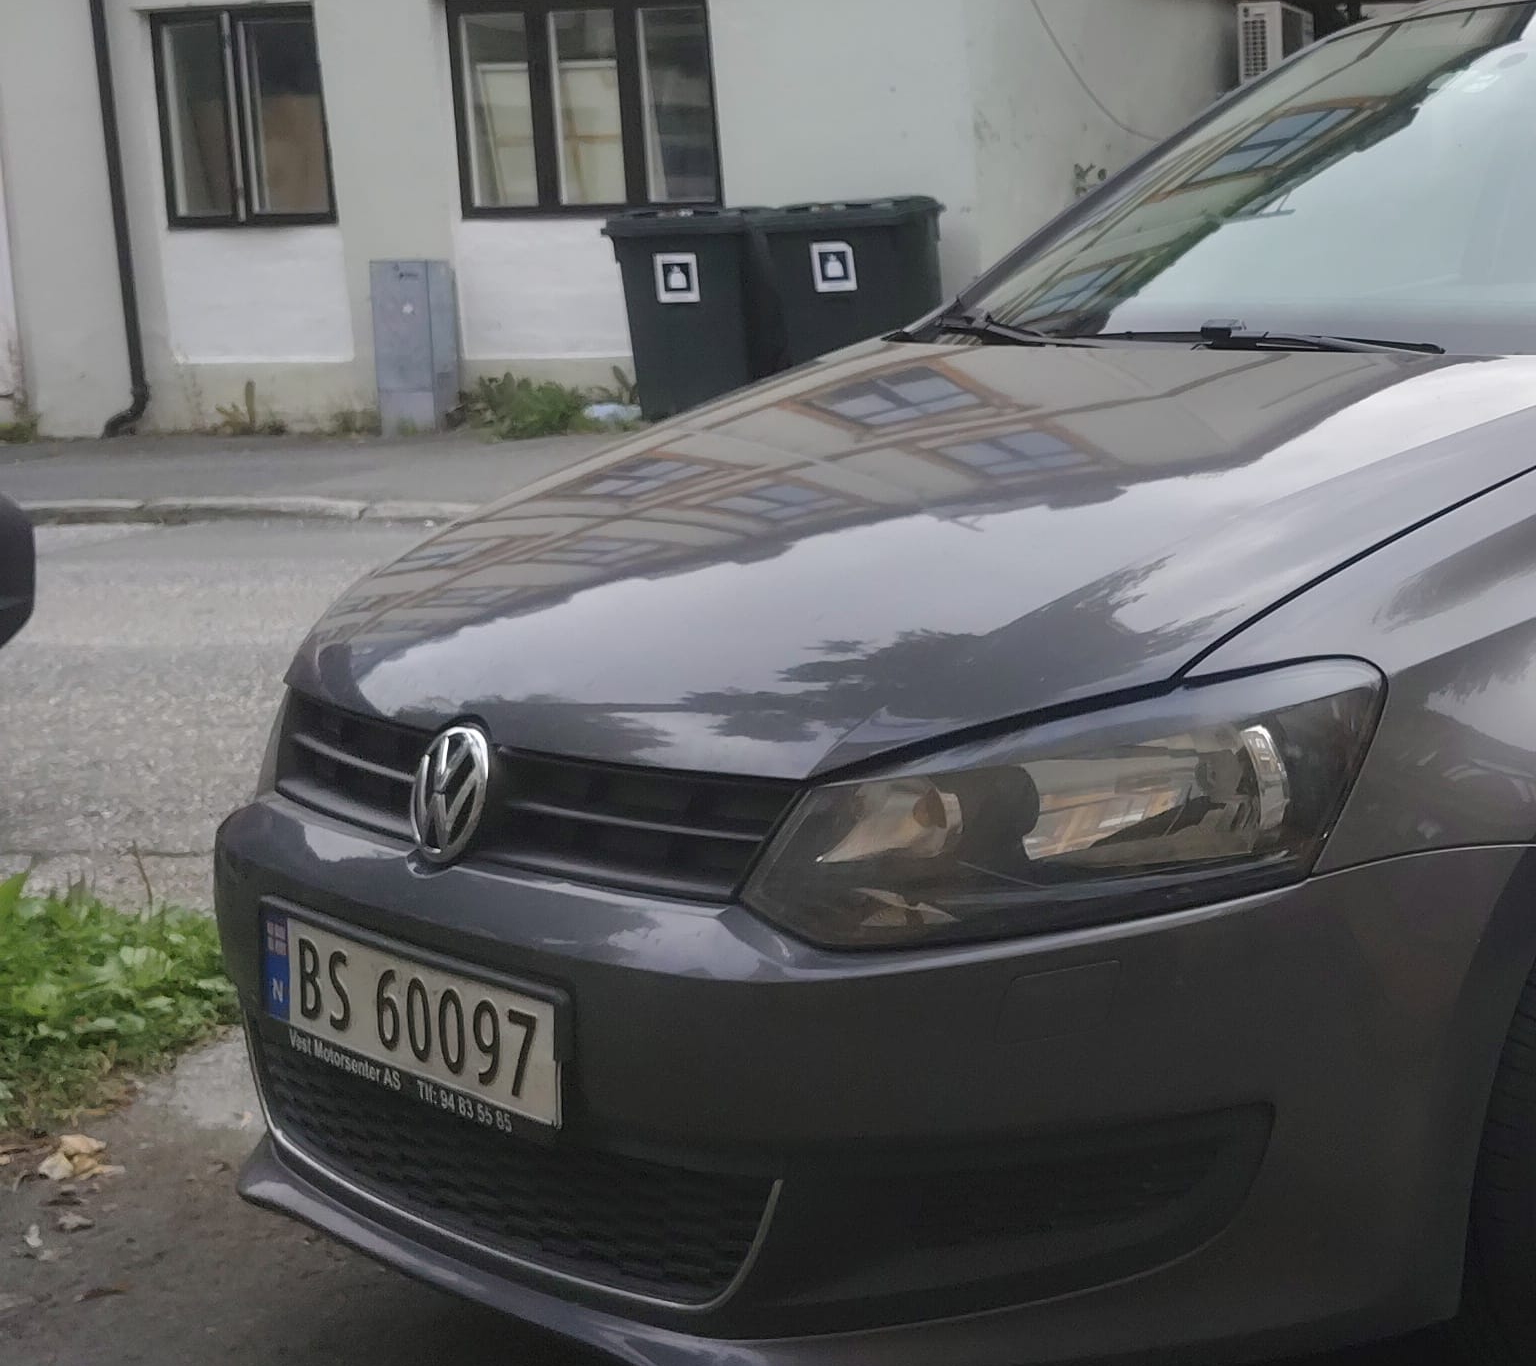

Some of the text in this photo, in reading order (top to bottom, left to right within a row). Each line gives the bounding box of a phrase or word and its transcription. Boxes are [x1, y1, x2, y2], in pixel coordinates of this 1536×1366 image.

[271, 977, 284, 1003] N
[299, 937, 537, 1098] BS 60097
[288, 1027, 312, 1058] Vest
[313, 1038, 381, 1084] Motorsenter
[383, 1067, 402, 1091] AS
